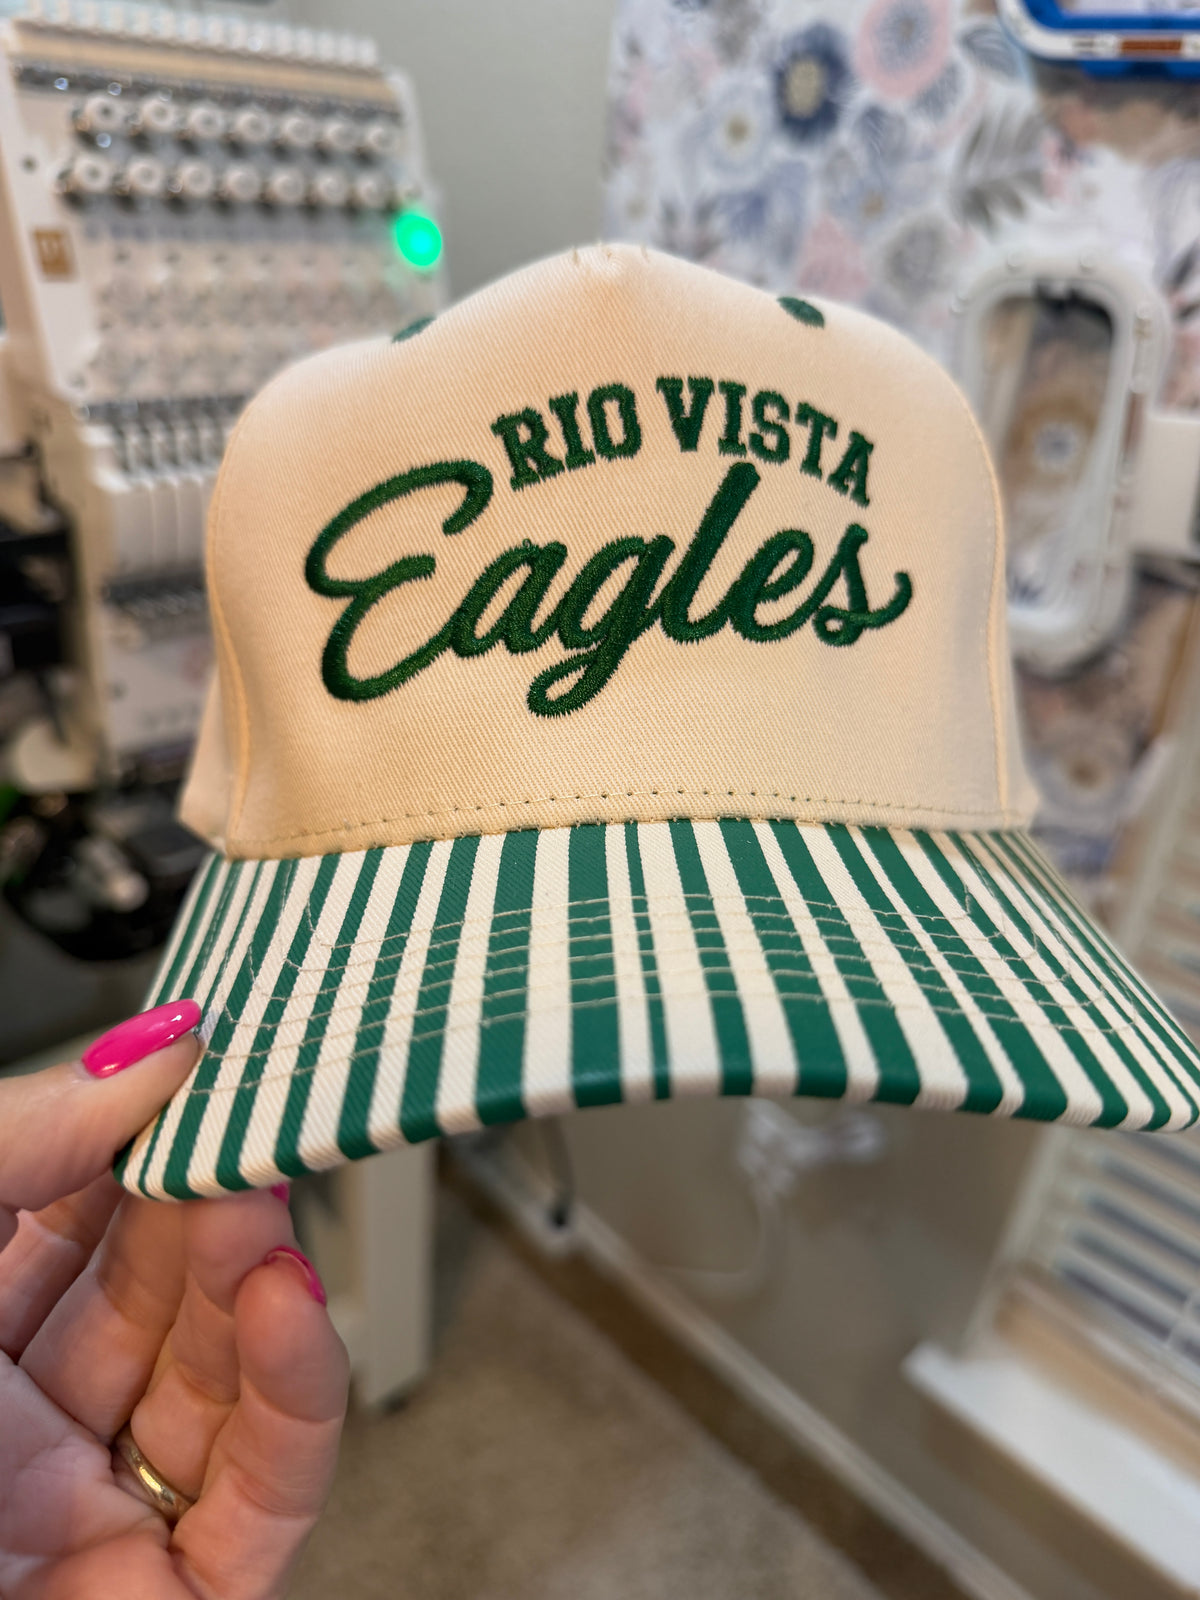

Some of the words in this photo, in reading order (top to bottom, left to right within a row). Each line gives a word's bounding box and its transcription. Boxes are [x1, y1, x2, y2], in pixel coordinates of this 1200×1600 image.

[490, 382, 643, 491] RIO
[656, 376, 875, 507] VISTA
[304, 460, 913, 718] Eagles
